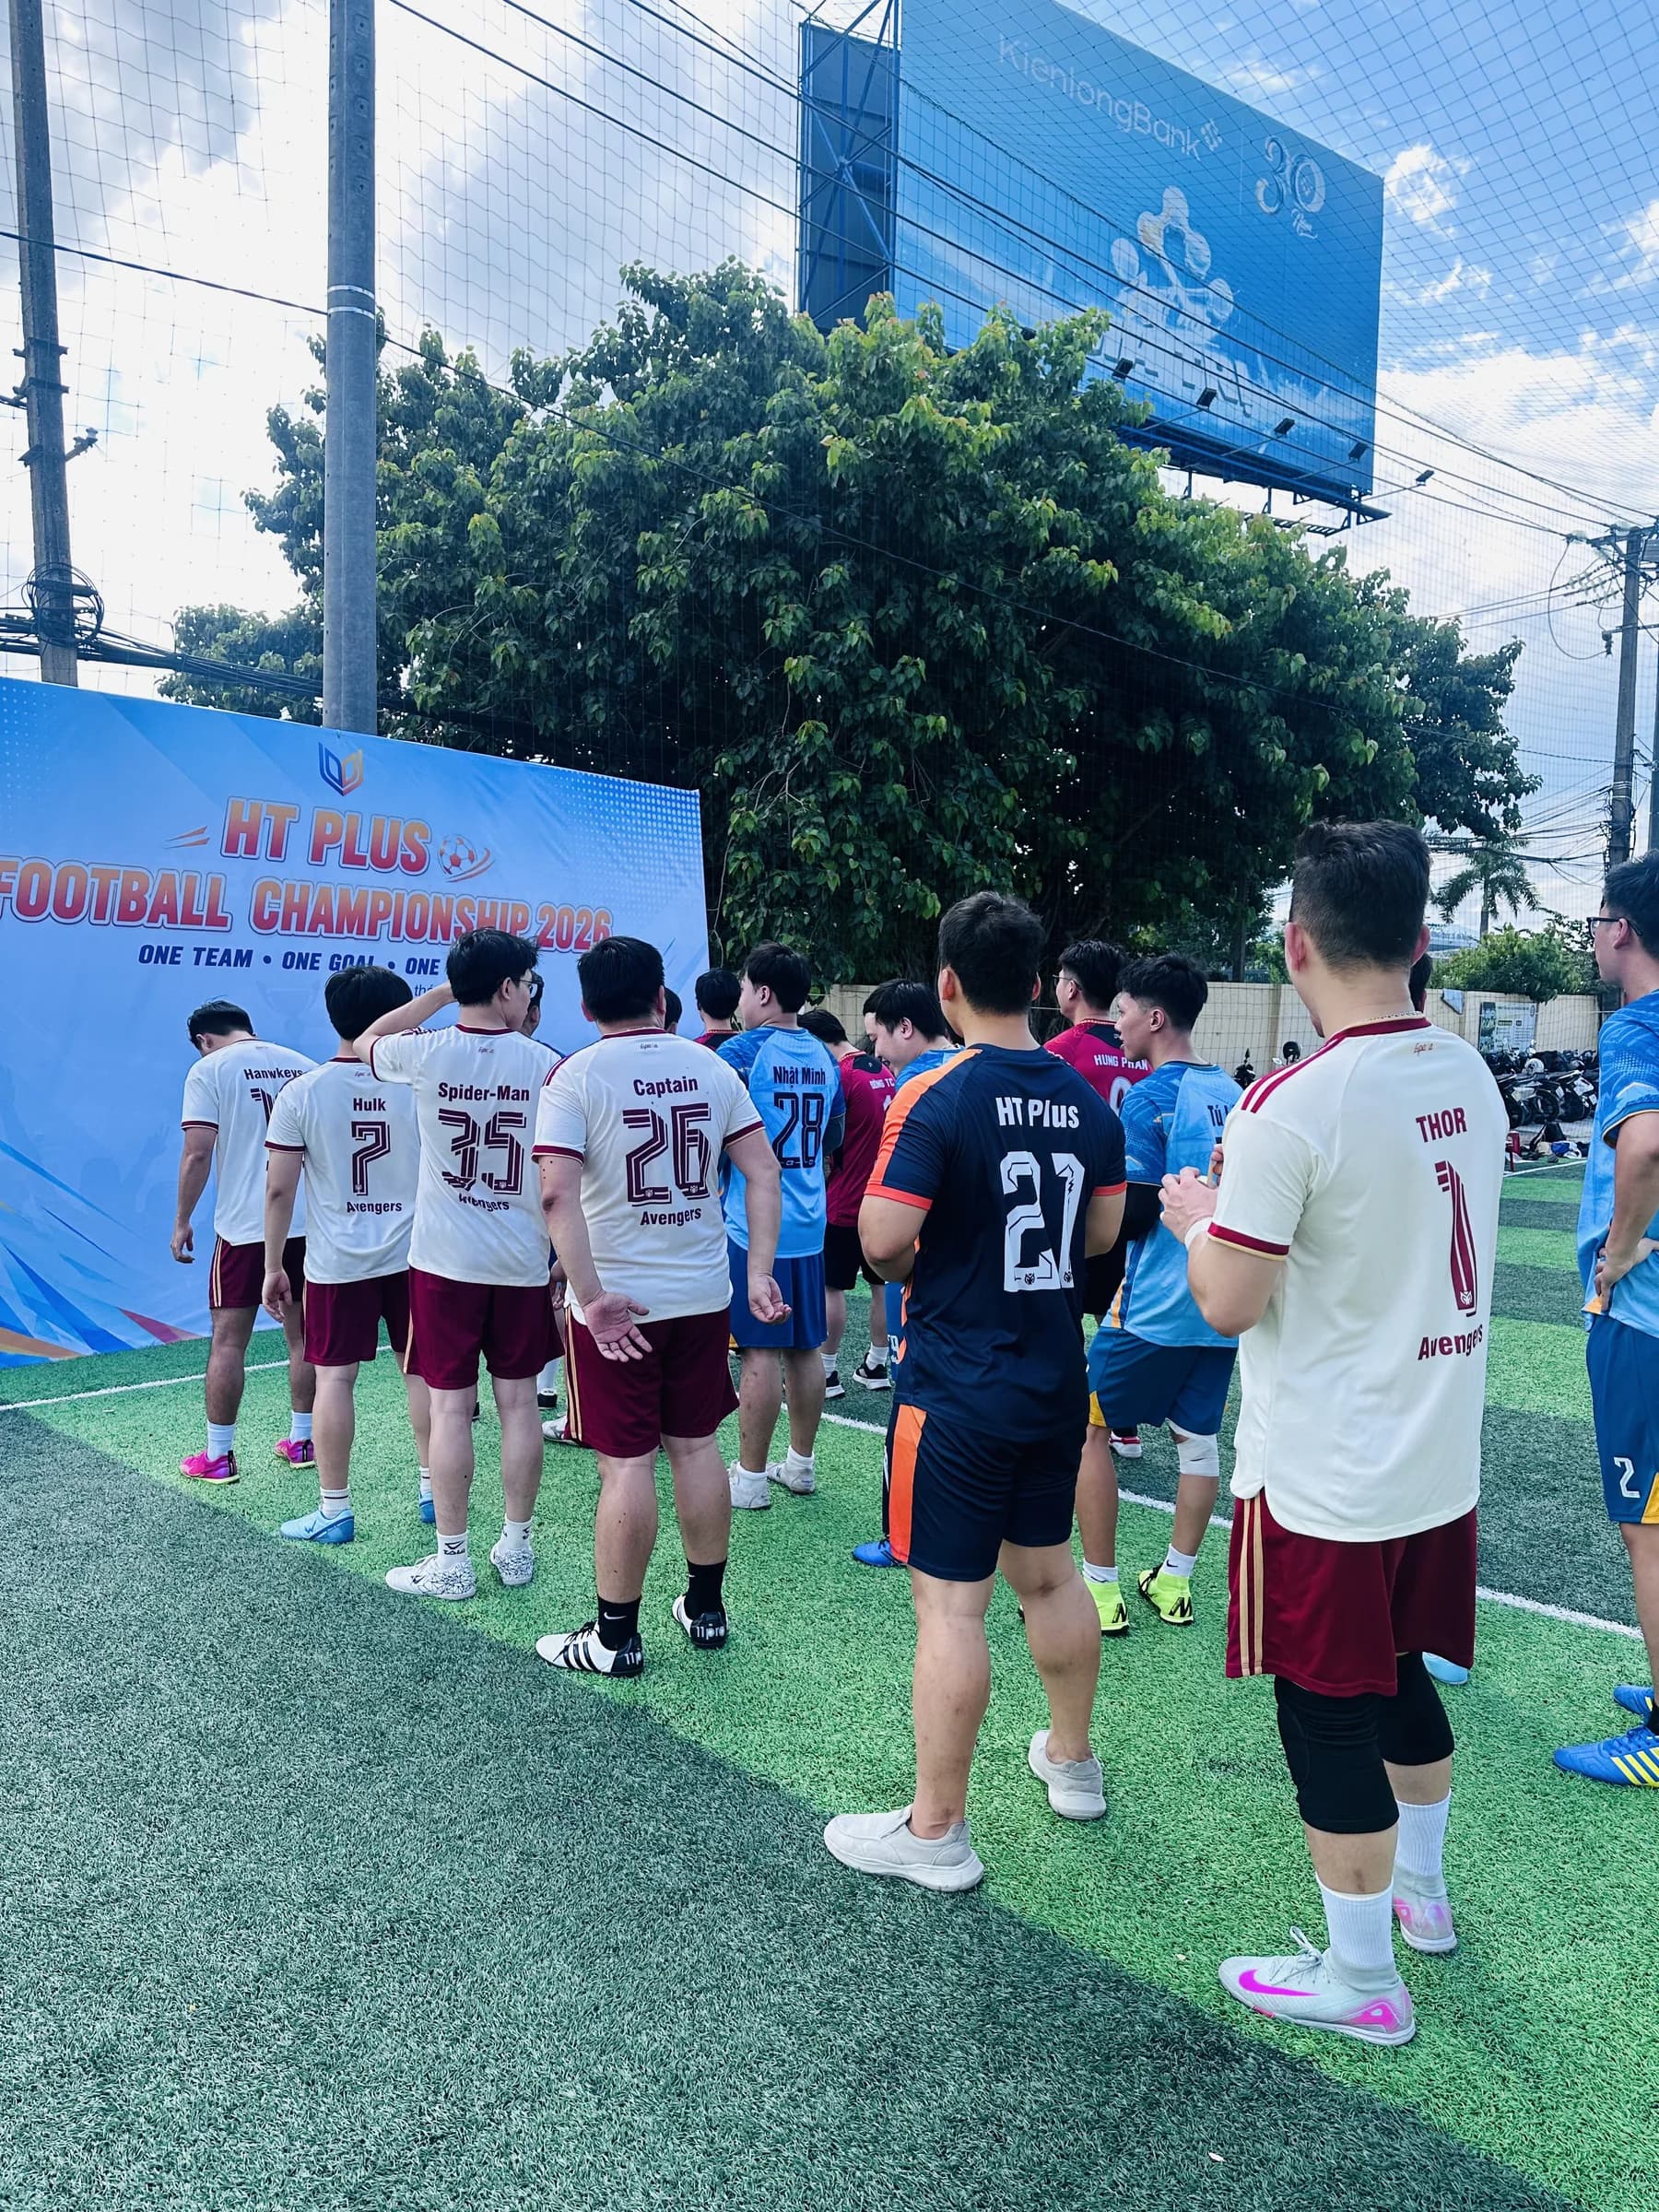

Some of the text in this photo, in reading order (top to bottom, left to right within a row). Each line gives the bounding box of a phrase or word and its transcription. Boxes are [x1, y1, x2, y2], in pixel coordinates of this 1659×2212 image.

[998, 35, 1201, 160] KienlongBank
[1255, 135, 1325, 214] 30
[222, 797, 430, 875] HT PLUS
[250, 877, 531, 944] CHAMPIONSHIP
[535, 900, 612, 952] 2026
[139, 945, 183, 965] ONE
[194, 947, 253, 968] TEAM
[282, 951, 321, 970] ONE
[406, 958, 440, 975] ONE
[438, 1082, 530, 1101] Spider-Man
[633, 1076, 699, 1097] Captain
[773, 1065, 826, 1088] Nhật Minh
[353, 1097, 386, 1112] Hulk
[995, 1097, 1080, 1129] HT Plus
[1416, 1107, 1467, 1142] THOR
[438, 1108, 527, 1195] 35
[772, 1091, 825, 1169] 28
[351, 1121, 391, 1195] 7
[622, 1102, 712, 1207] 26
[347, 1200, 403, 1215] Avengers
[640, 1206, 702, 1226] Avengers
[1434, 1159, 1477, 1317] 1
[1614, 1456, 1641, 1499] 2
